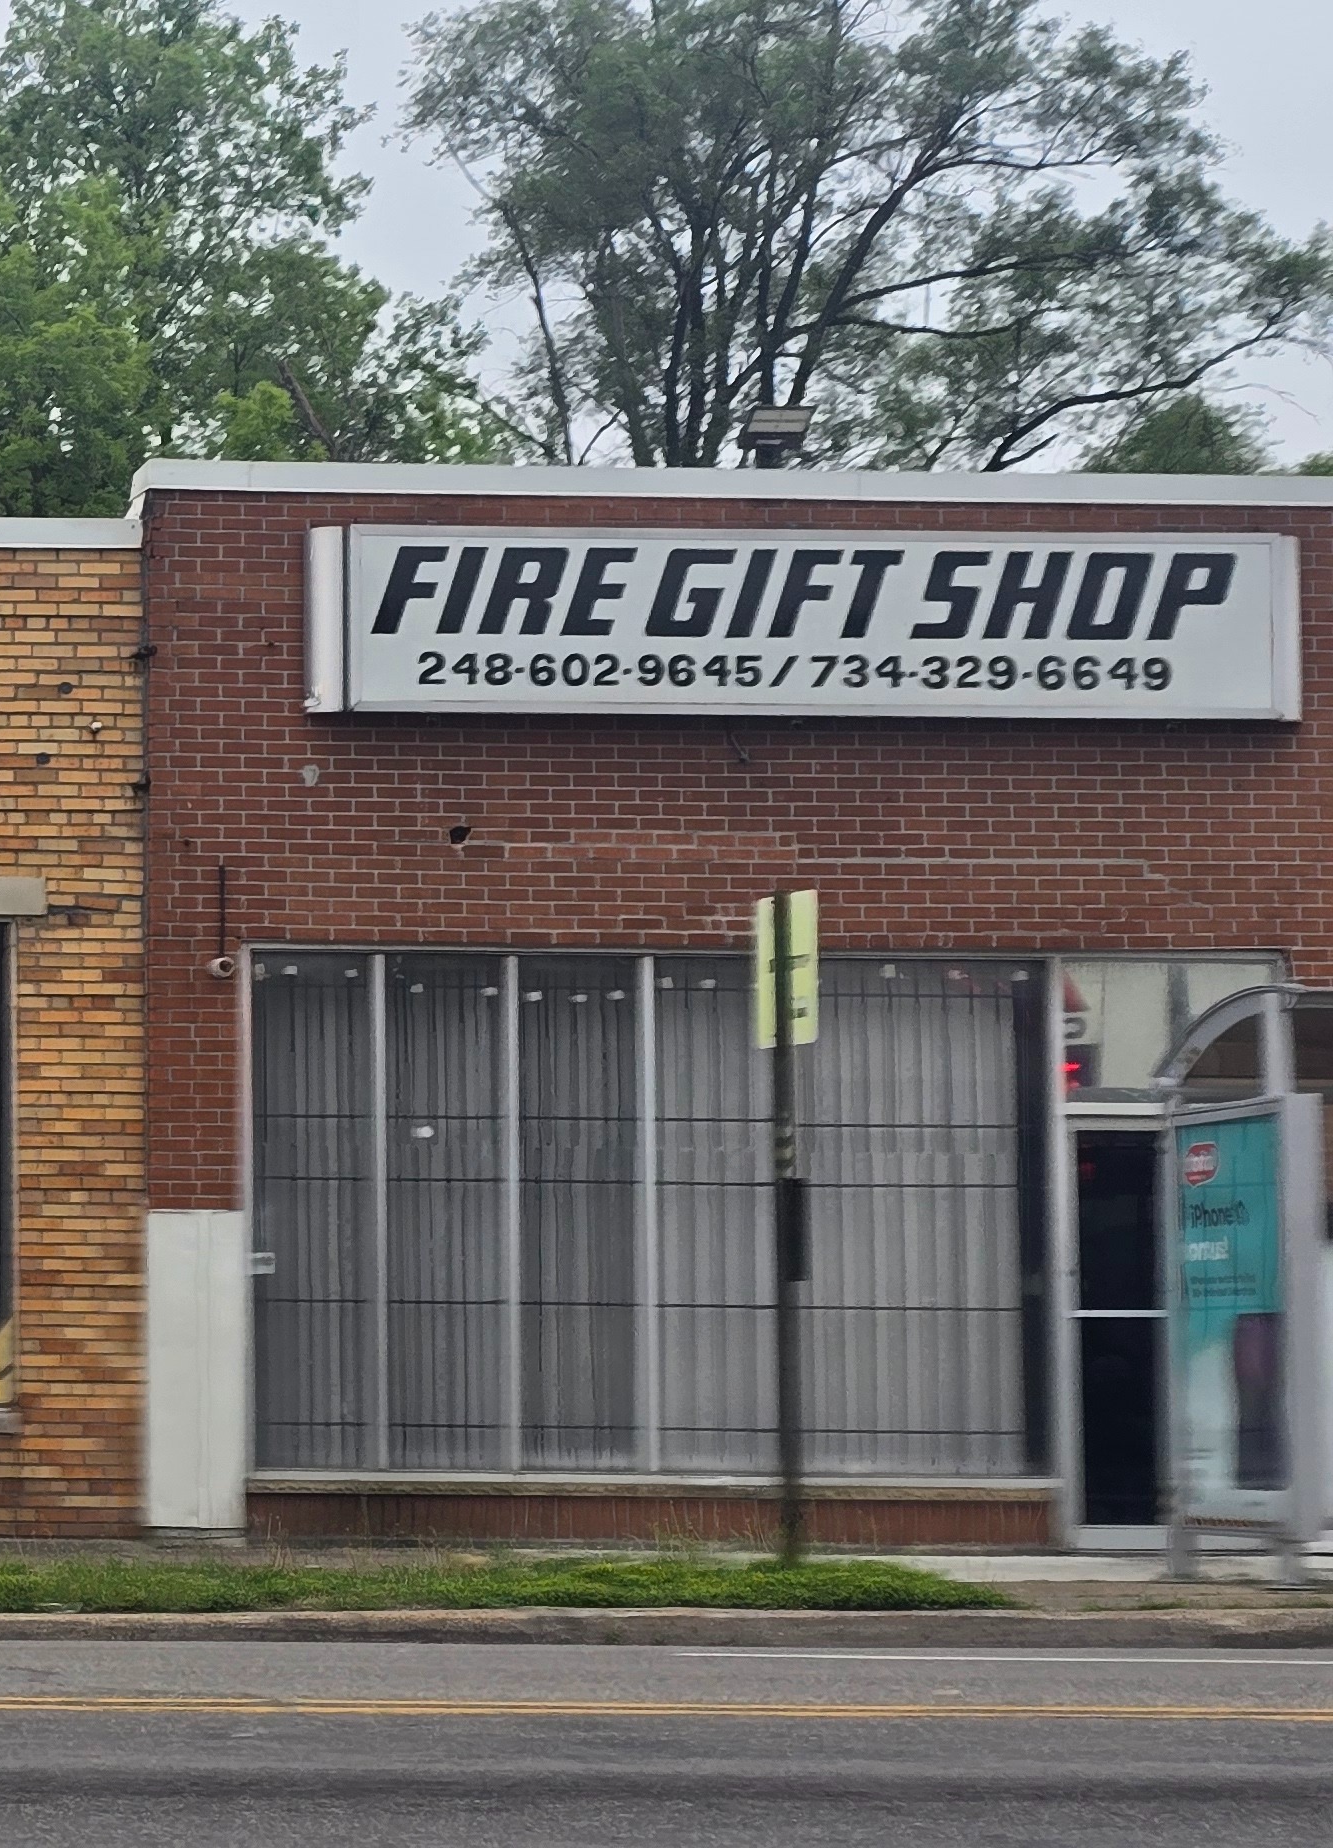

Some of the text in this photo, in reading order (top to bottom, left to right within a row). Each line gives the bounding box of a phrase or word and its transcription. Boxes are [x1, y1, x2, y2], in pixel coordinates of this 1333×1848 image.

[371, 546, 1238, 640] FIRE GIFT SHOP
